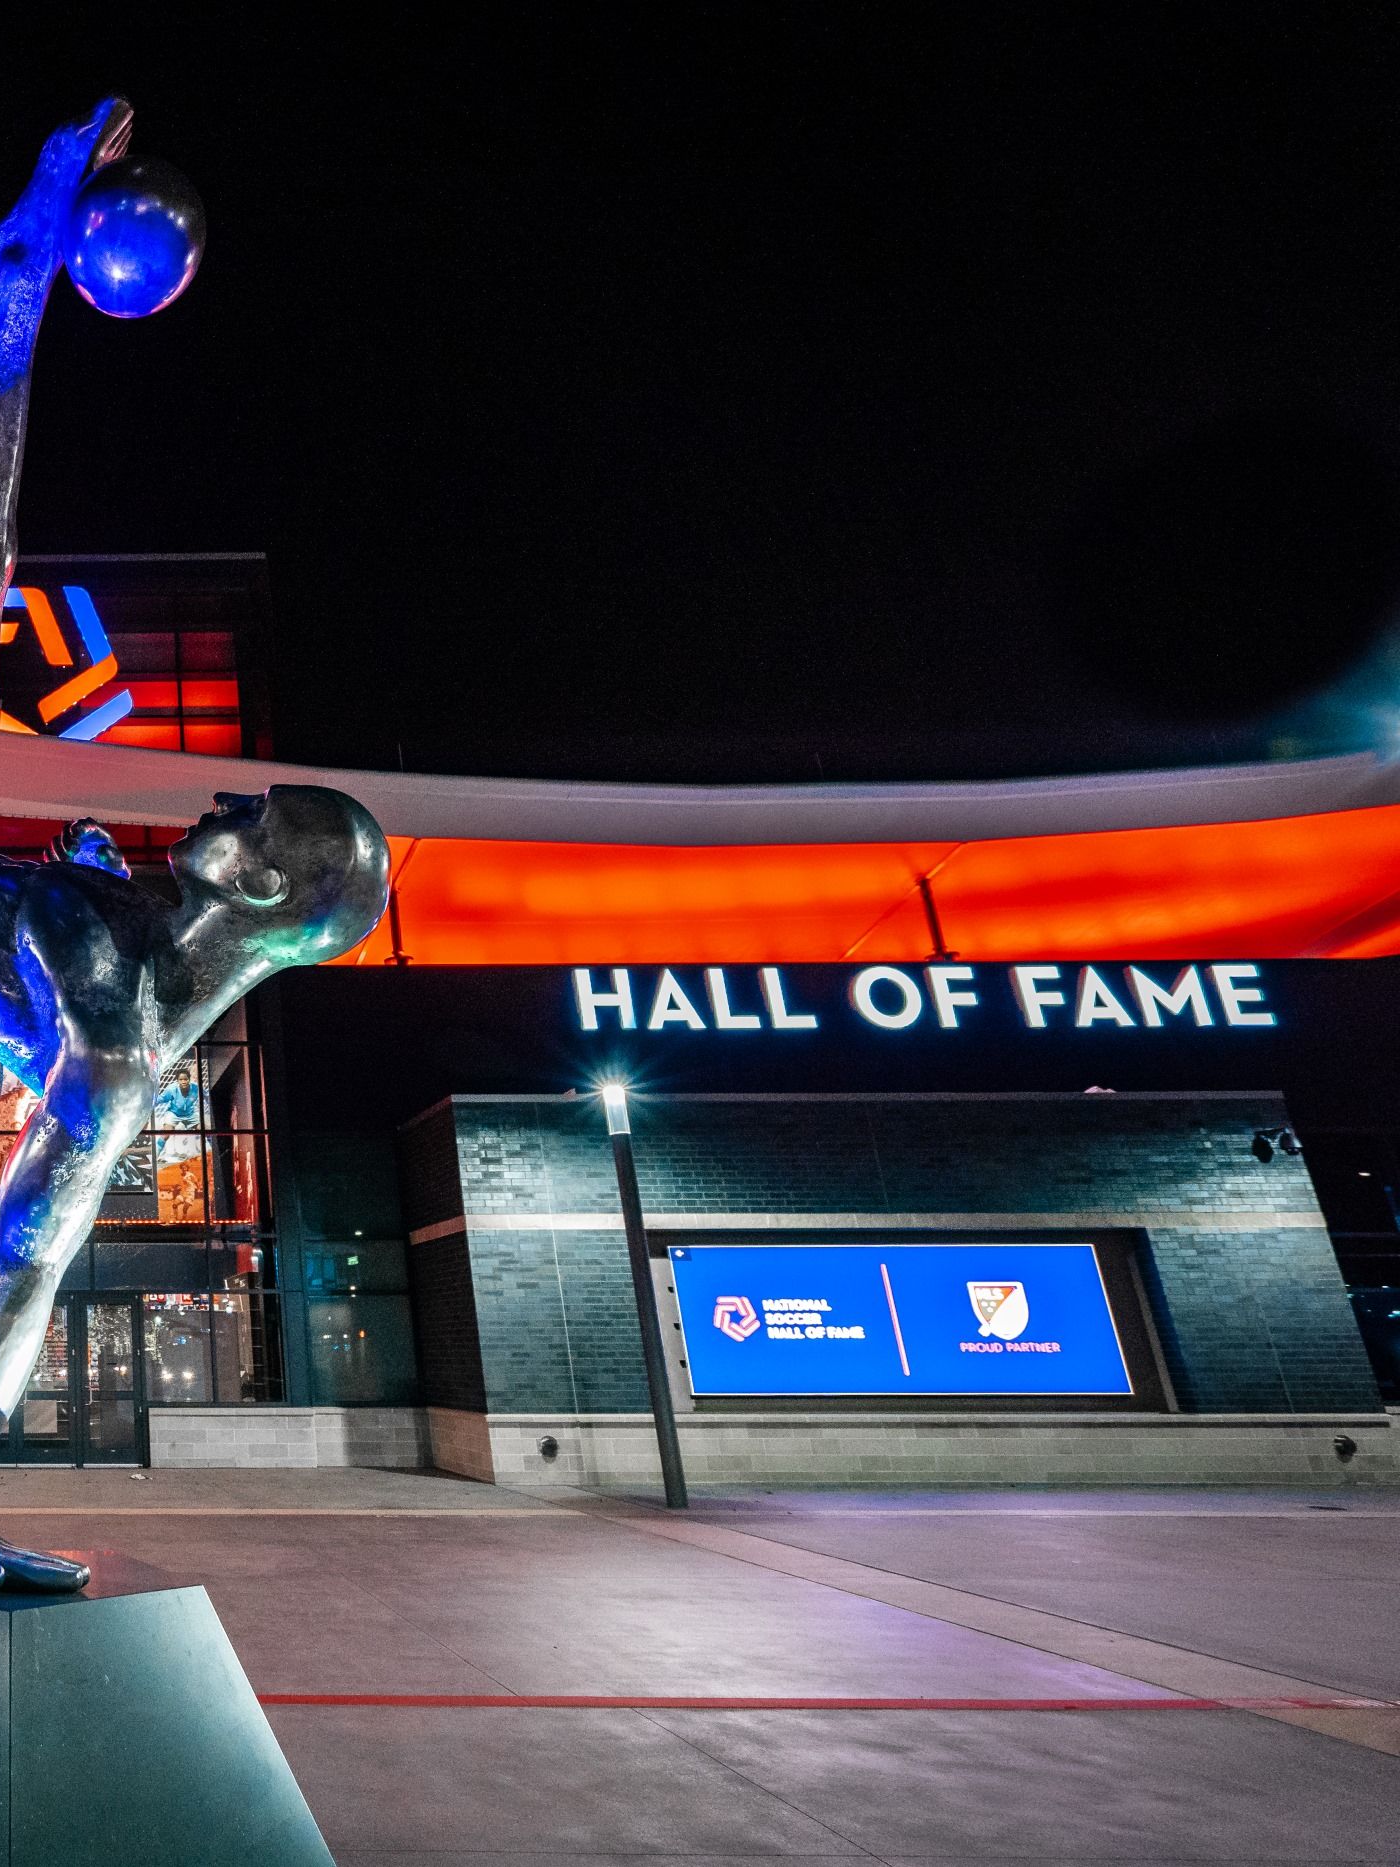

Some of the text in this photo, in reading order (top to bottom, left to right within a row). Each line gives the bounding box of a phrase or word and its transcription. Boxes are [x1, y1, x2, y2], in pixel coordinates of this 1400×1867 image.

[573, 964, 1275, 1030] HALL OF FAME
[762, 1299, 832, 1311] NATIONAL
[765, 1312, 822, 1325] SOCCER
[767, 1325, 865, 1339] HALL OF FAME
[960, 1342, 1061, 1352] PROUD PARTNER
